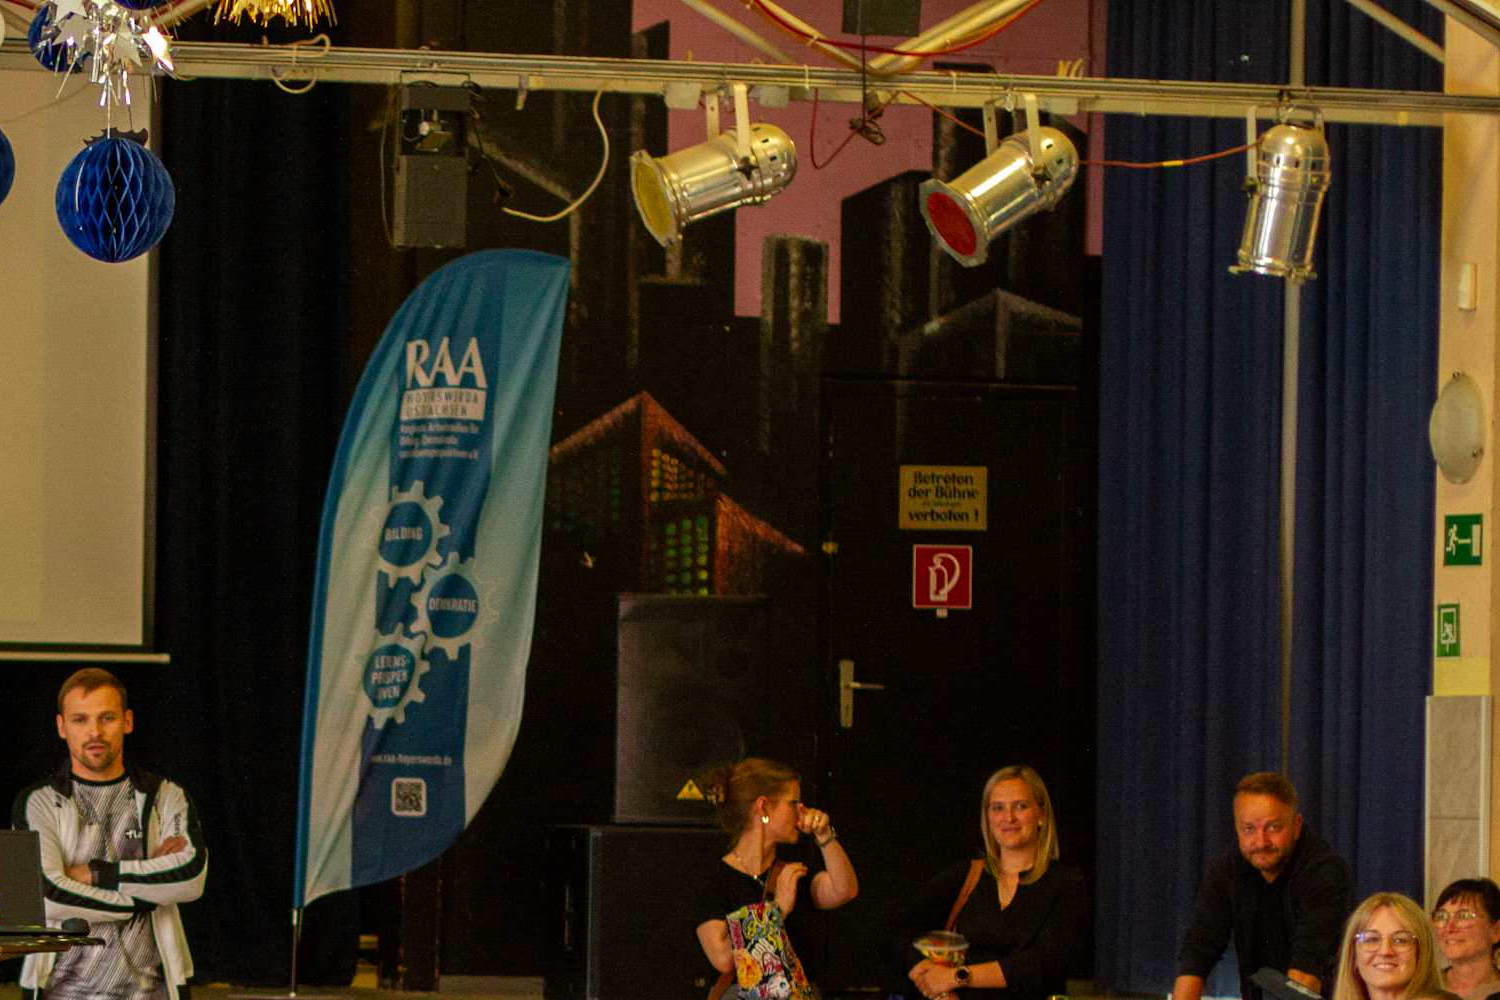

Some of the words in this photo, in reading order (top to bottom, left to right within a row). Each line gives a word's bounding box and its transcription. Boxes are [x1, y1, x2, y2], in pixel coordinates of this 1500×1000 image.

[406, 336, 488, 388] RAA
[914, 471, 974, 484] Betreten
[908, 485, 931, 497] der
[936, 486, 980, 499] Bühne
[908, 509, 969, 521] verboten
